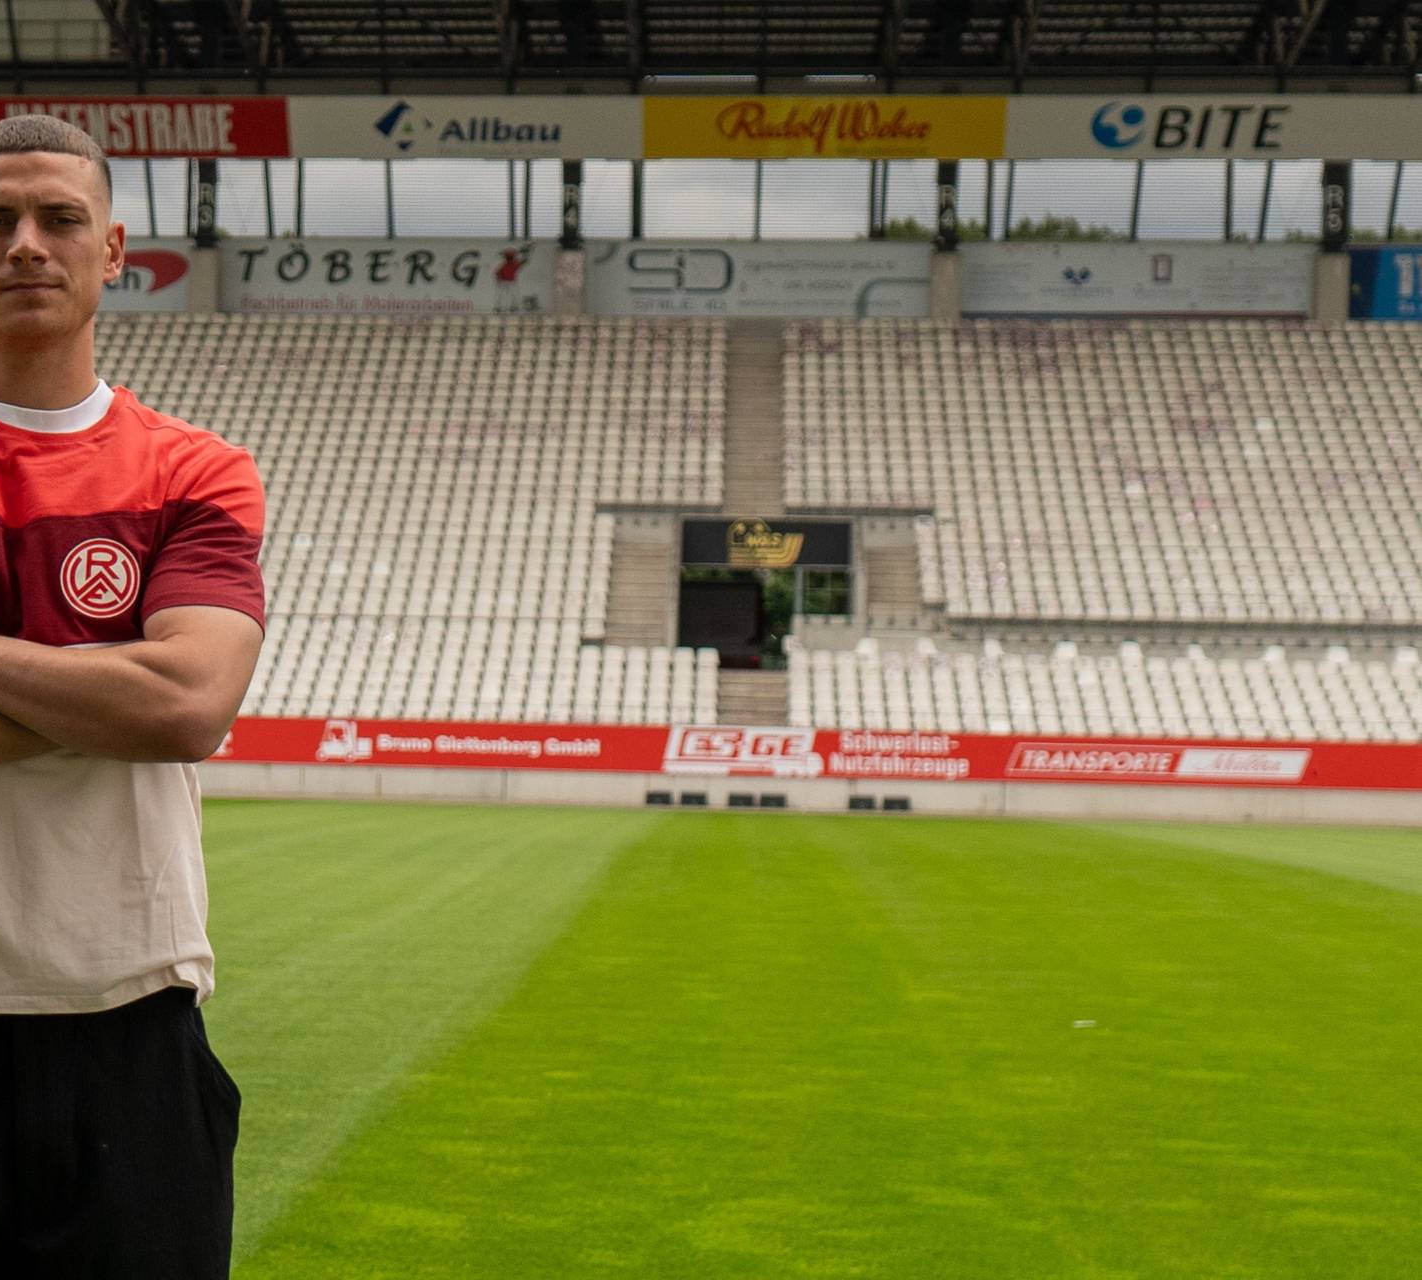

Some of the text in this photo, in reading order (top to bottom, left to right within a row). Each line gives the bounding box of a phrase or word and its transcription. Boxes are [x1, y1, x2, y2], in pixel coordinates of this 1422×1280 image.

[439, 117, 561, 143] Allbau
[716, 101, 931, 153] Rudolf Weber
[1154, 104, 1291, 149] BITE
[239, 243, 479, 289] TÖBERG
[828, 752, 971, 781] Nutzfahrzeuge
[1021, 749, 1174, 773] TRANSPORTE
